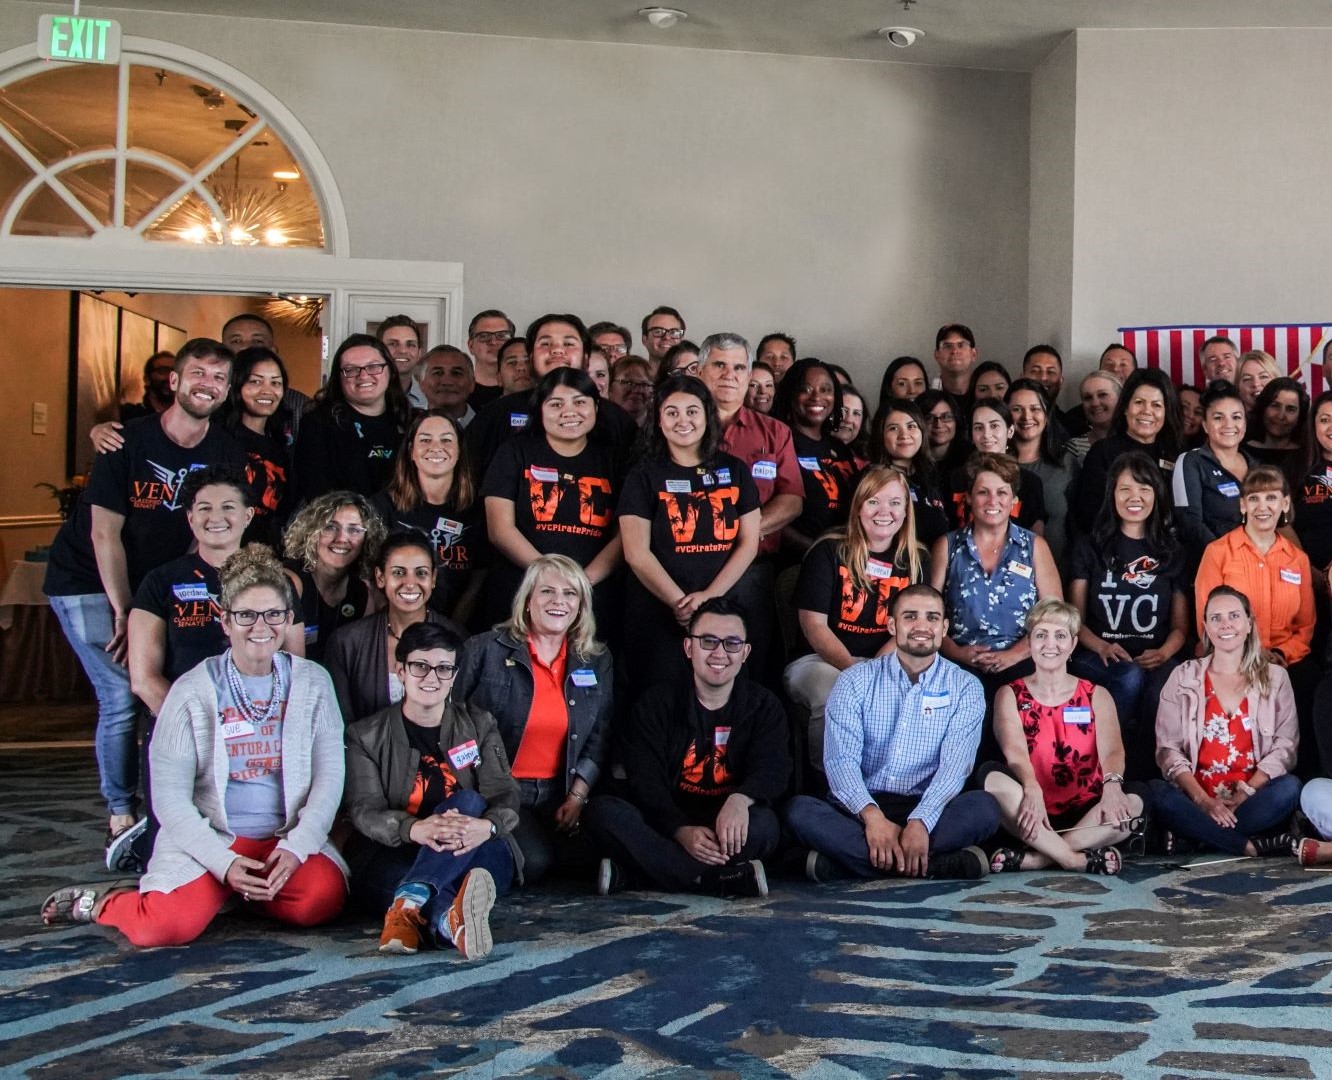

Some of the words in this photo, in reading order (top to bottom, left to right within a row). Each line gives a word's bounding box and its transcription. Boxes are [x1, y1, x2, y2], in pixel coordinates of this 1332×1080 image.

[51, 16, 112, 60] EXIT
[525, 469, 613, 527] VC
[658, 486, 740, 543] VC
[173, 615, 212, 624] CLASSIFIED
[1098, 594, 1159, 633] VC
[260, 724, 276, 736] OF
